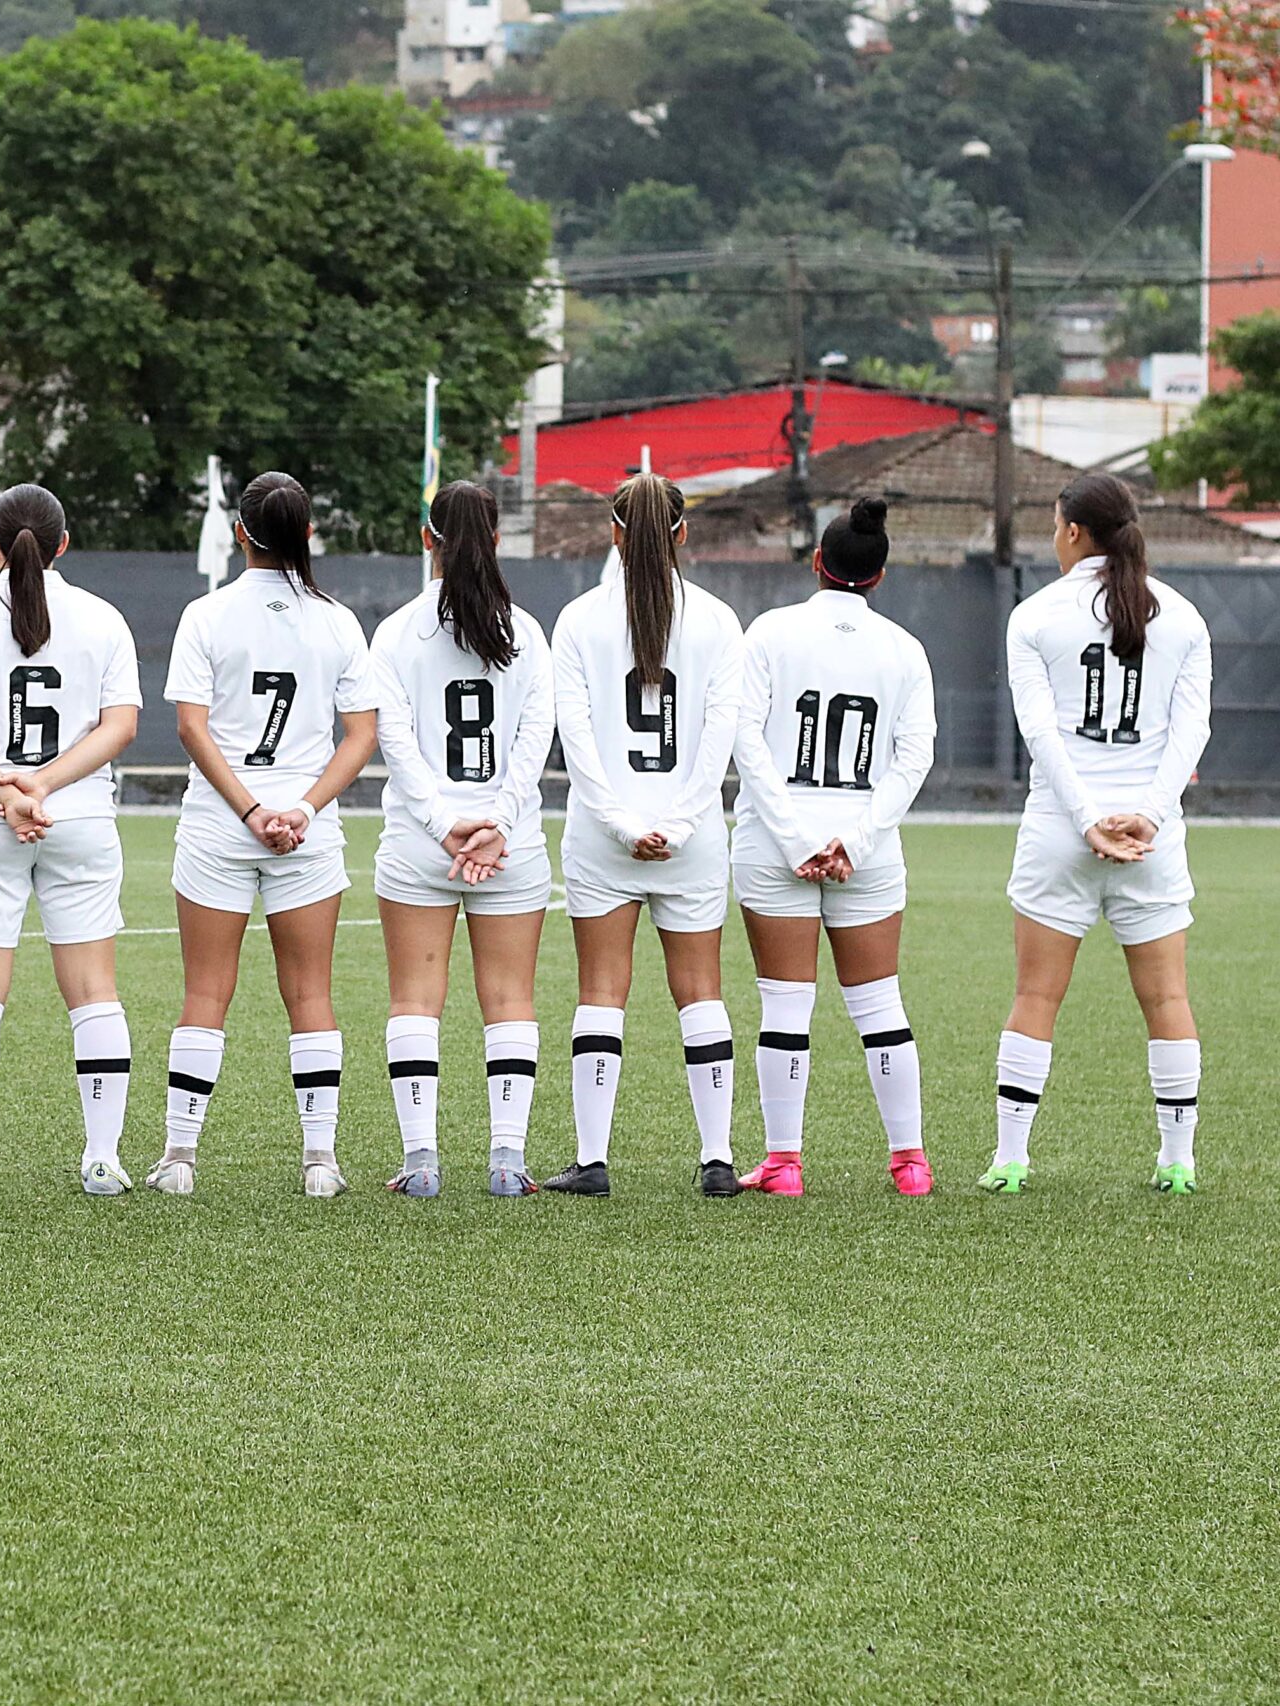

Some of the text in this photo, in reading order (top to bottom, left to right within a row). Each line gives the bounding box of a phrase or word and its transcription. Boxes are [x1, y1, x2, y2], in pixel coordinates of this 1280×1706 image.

[6, 666, 61, 767] 6
[244, 671, 298, 766] 7
[444, 679, 495, 783] 8
[625, 667, 677, 773] 9
[787, 689, 879, 790] 10
[1076, 643, 1144, 744] 11
[411, 1082, 420, 1105] SFC
[502, 1079, 511, 1101] SFC
[597, 1059, 605, 1086] SFC
[790, 1057, 799, 1080] SFC
